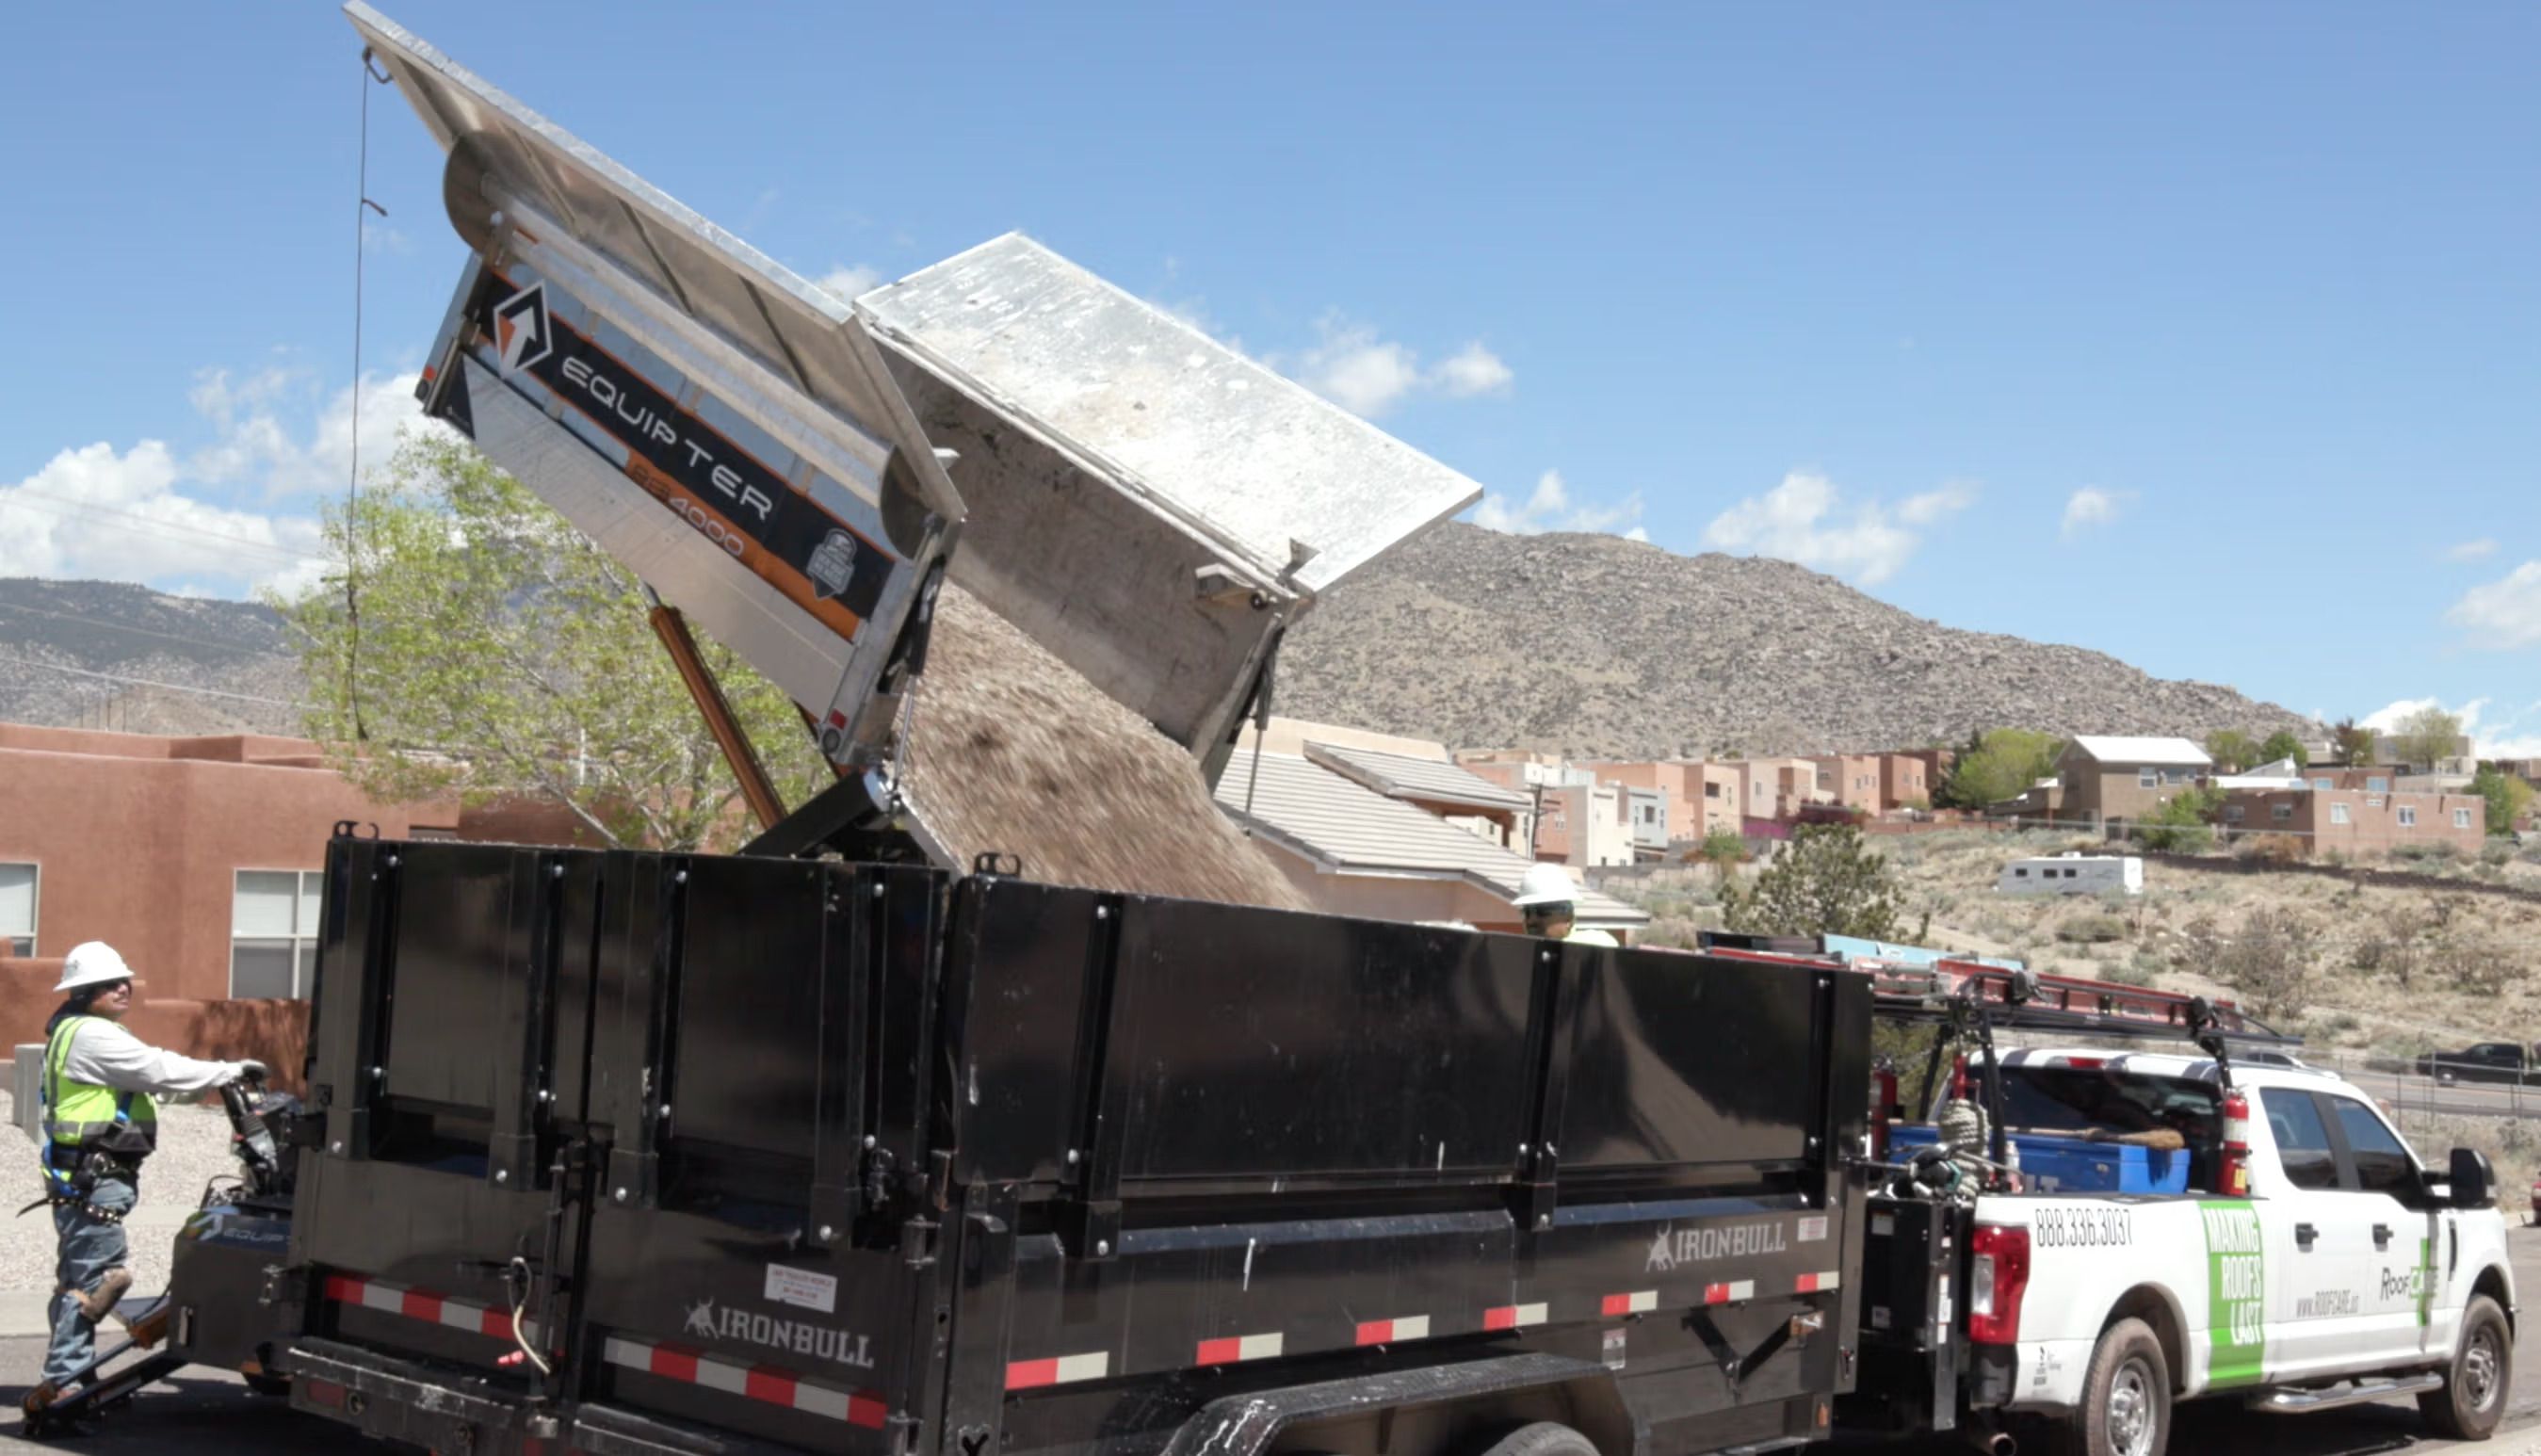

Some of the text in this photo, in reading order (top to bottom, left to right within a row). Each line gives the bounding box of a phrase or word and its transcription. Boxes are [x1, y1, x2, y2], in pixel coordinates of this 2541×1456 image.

[224, 1226, 288, 1244] EQUIP
[1675, 1222, 1786, 1262] IRONBULL
[2035, 1207, 2132, 1247] 888.336.3037
[2203, 1207, 2261, 1253] MAKING
[2221, 1254, 2262, 1301] ROOFS
[720, 1306, 874, 1368] IRONBULL
[2230, 1301, 2262, 1346] LAST
